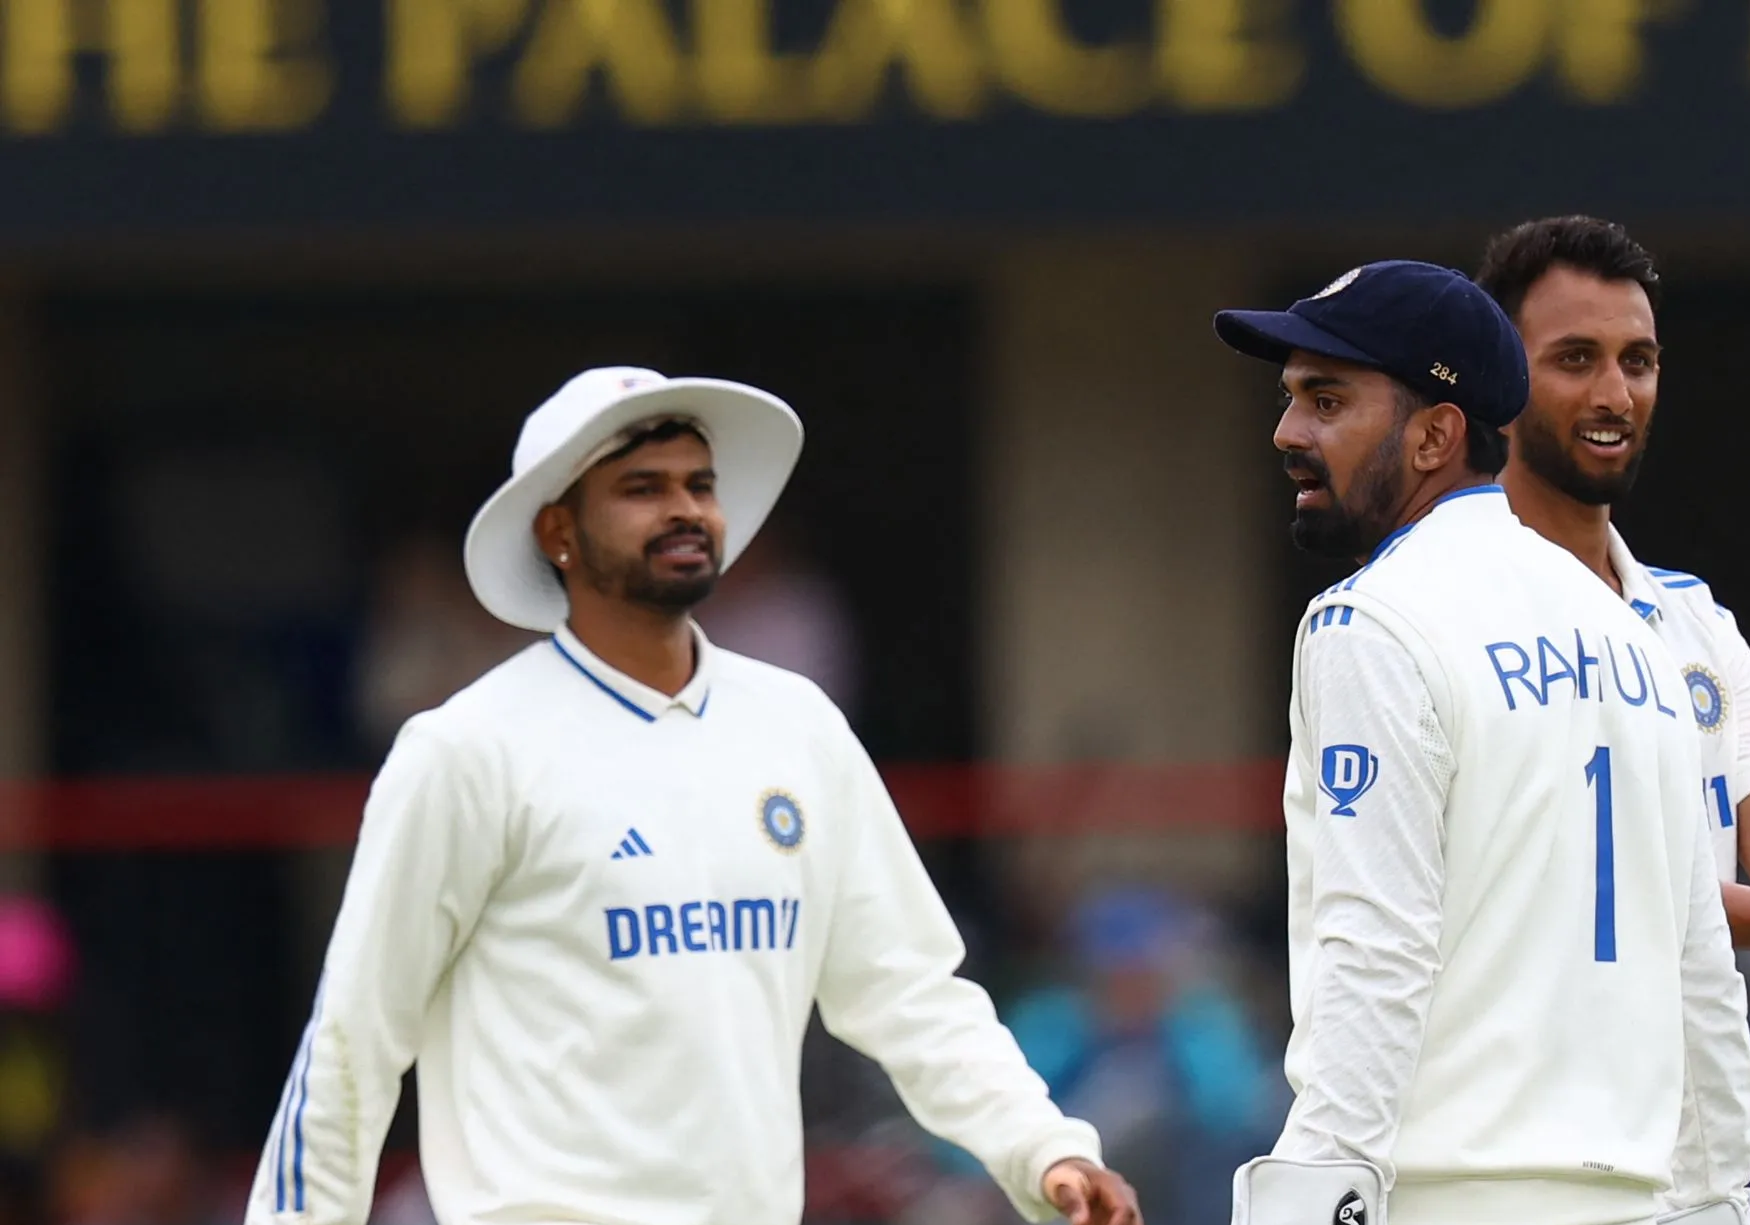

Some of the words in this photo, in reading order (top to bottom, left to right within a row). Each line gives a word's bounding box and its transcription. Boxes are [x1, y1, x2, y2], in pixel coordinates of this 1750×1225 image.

[385, 0, 1305, 127] PALACE
[1335, 0, 1645, 110] OF
[1430, 361, 1458, 385] 284
[1485, 628, 1676, 719] RAHUL
[1584, 746, 1616, 962] 1
